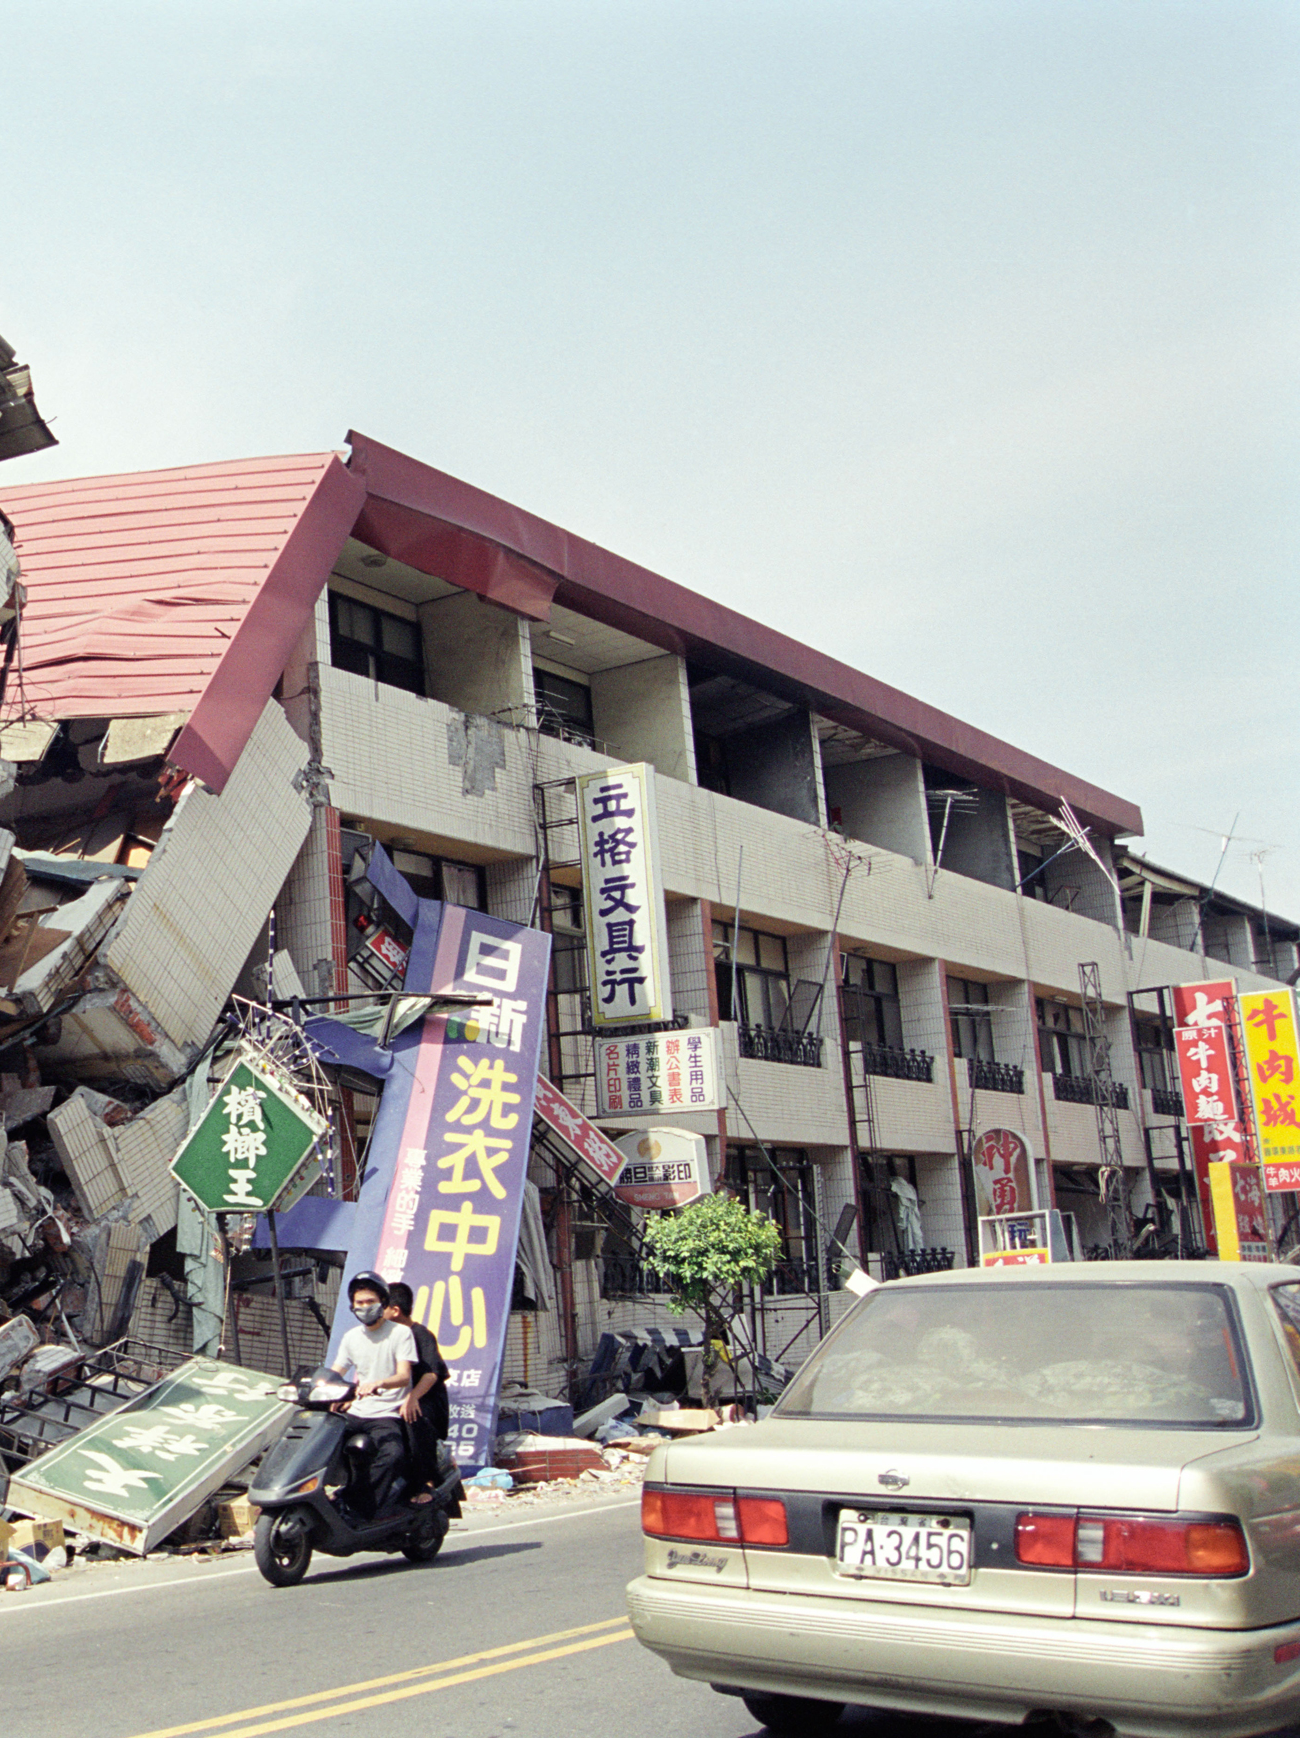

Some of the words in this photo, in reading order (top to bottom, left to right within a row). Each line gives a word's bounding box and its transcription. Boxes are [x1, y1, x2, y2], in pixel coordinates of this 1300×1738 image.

[605, 1044, 623, 1110] 名片印刷
[645, 1040, 663, 1106] 新潮文具
[687, 1036, 705, 1103] 學生用品
